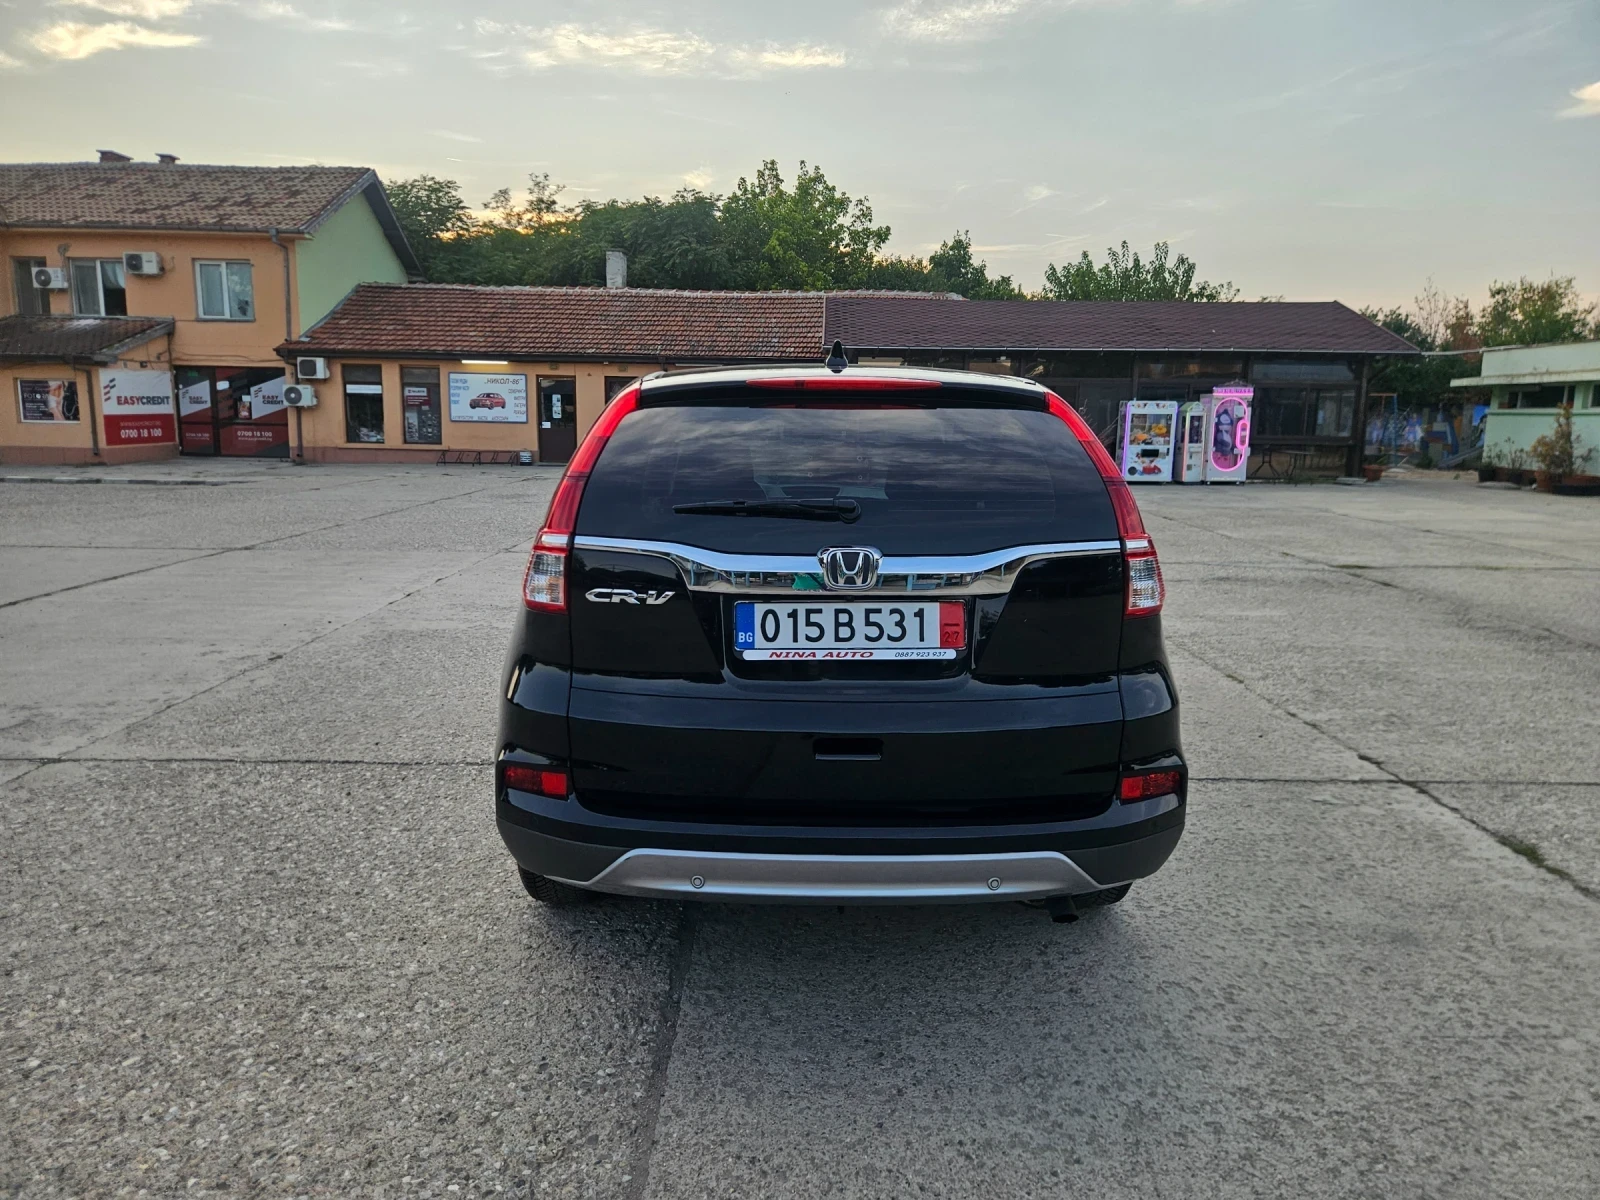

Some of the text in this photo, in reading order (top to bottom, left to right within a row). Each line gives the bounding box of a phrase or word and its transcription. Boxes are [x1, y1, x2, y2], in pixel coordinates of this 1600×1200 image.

[116, 395, 170, 406] EASYCREDIT
[120, 428, 162, 438] 0700 18 100
[585, 588, 676, 605] CR-V
[760, 608, 925, 643] 015B531
[738, 632, 753, 643] BG
[768, 651, 874, 659] NINA AUTO
